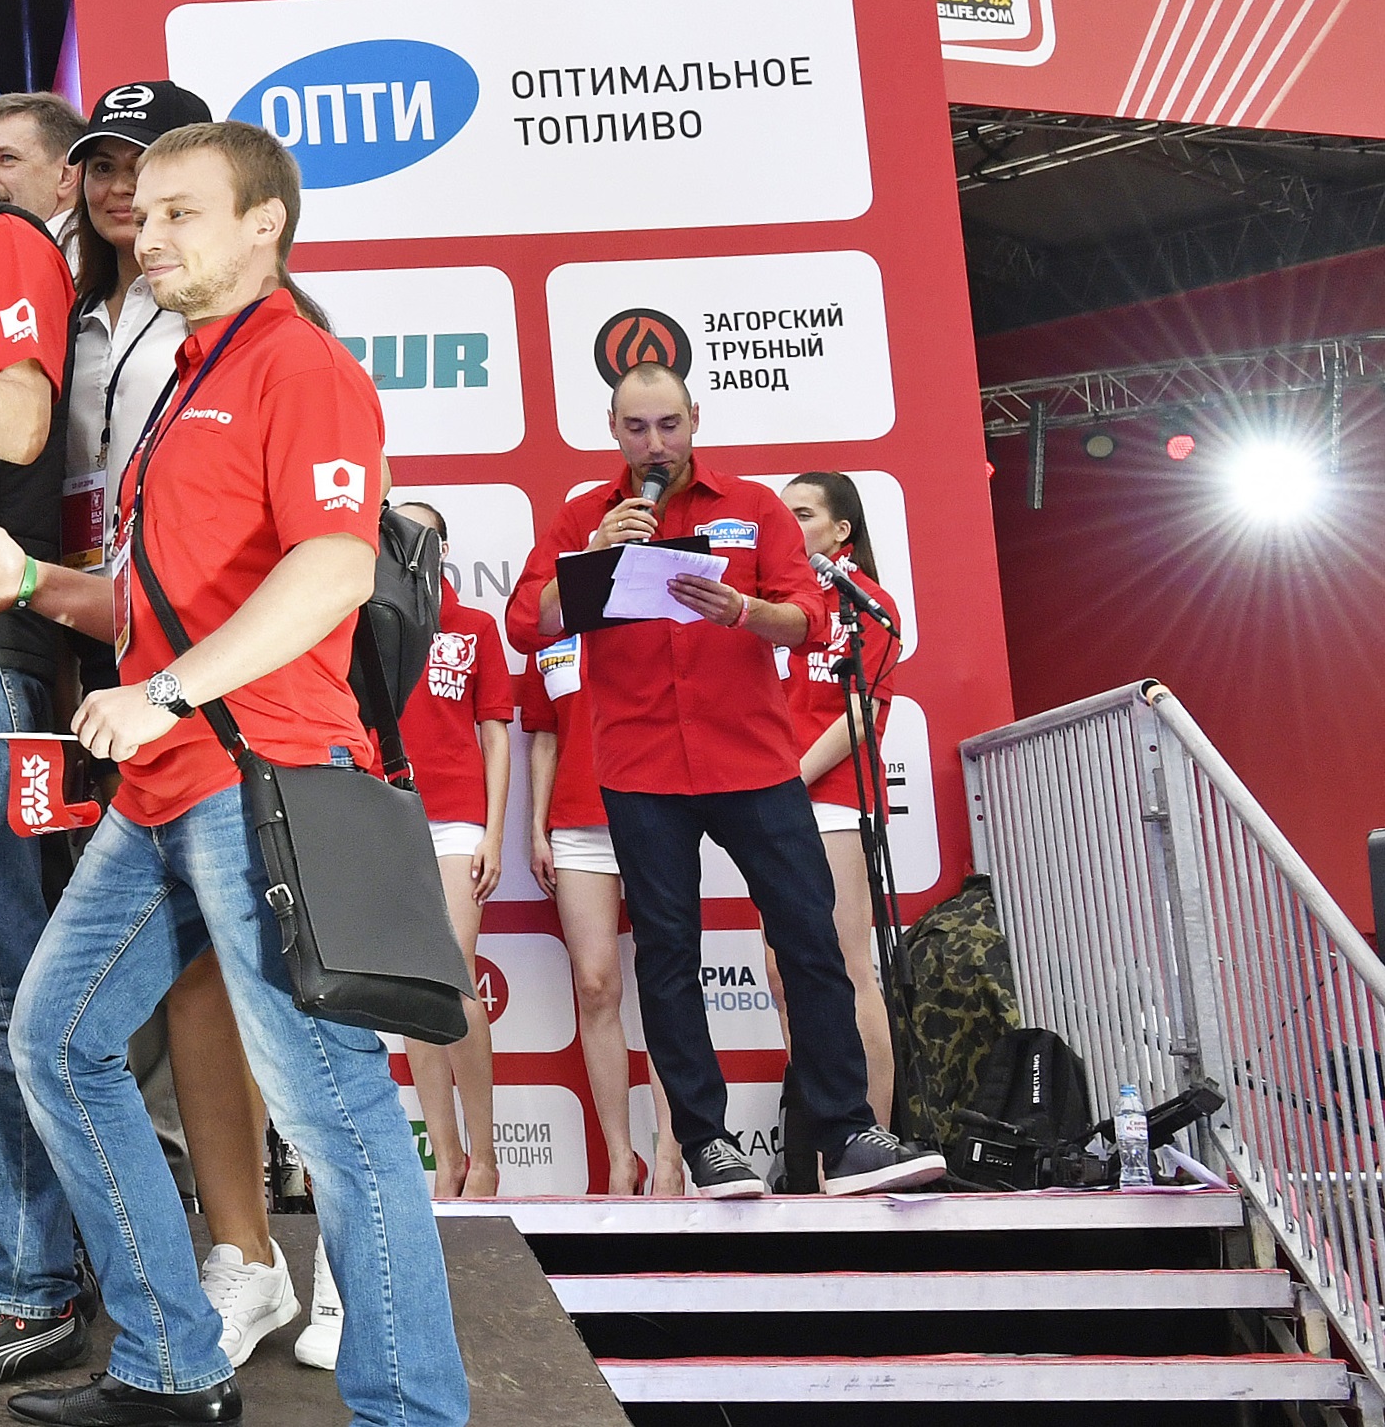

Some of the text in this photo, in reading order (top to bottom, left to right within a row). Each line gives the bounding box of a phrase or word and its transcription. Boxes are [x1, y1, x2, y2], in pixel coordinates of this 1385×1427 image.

[937, 3, 1014, 23] BLIFE.COM
[510, 55, 814, 100] ОПТИМАЛЬНОЕ
[102, 108, 147, 122] HINO
[258, 79, 436, 149] ОПТИ
[513, 108, 704, 148] ТОПЛИВО
[702, 302, 845, 335] ЗАГОРСКИЙ
[704, 333, 826, 363] ТРУБНЫЙ
[708, 367, 791, 394] ЗАВОД
[193, 408, 233, 425] HINO
[323, 496, 360, 513] JAPAN
[729, 527, 752, 535] WAY
[427, 668, 467, 689] SILK
[428, 683, 466, 702] WAY
[19, 755, 40, 827] SILK
[34, 753, 55, 826] WAY
[701, 966, 757, 988] РИА
[1031, 1053, 1041, 1104] BREITLING
[492, 1123, 552, 1144] ОССИЯ
